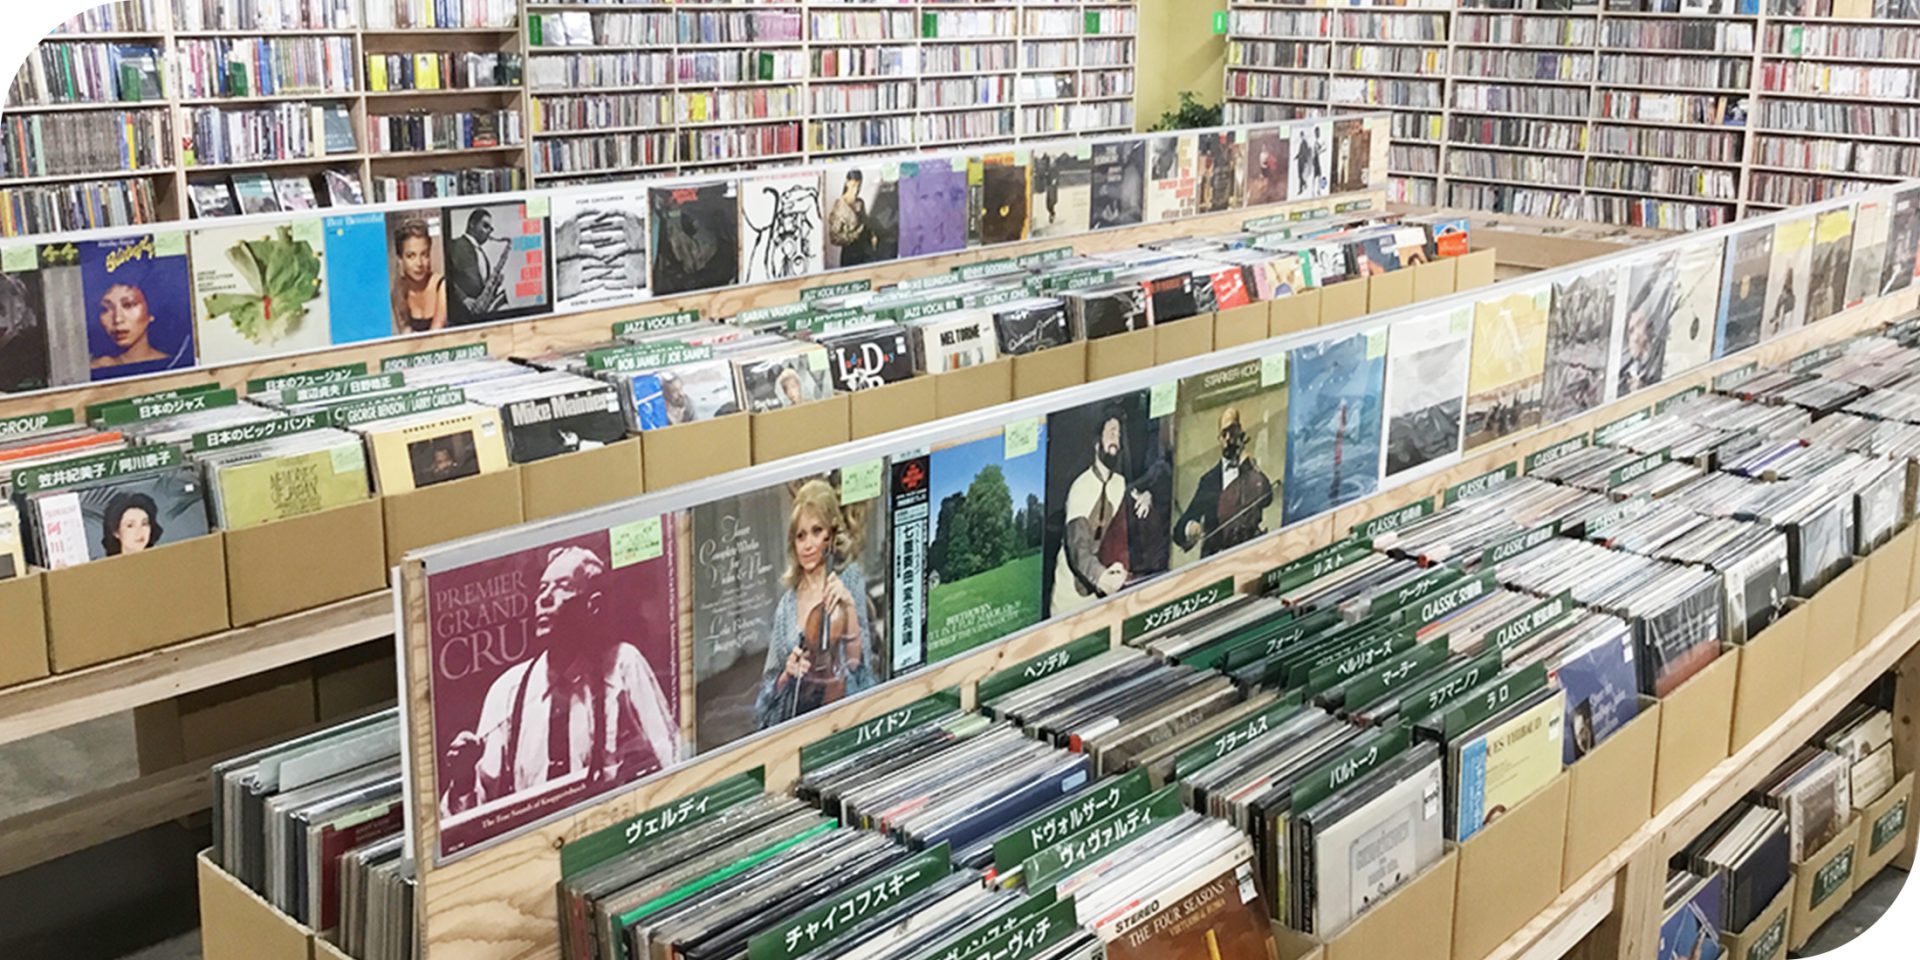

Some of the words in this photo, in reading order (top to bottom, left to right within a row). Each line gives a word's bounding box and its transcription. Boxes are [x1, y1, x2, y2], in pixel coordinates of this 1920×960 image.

[624, 320, 646, 334] JAZZ
[647, 316, 676, 330] VOCAL
[617, 357, 635, 371] BOB
[636, 353, 661, 368] JAMES
[667, 350, 683, 364] JOE
[682, 346, 711, 361] SAMPLE
[139, 395, 206, 420] 日本のジャズ
[347, 405, 378, 423] GEORGE
[510, 401, 552, 427] Mike
[206, 415, 317, 447] 日本のビッグ・バンド
[1456, 476, 1487, 500] CLASSIC
[1366, 512, 1401, 537] CLASSIC
[1312, 553, 1344, 578] リスト
[1492, 536, 1526, 562] CLASSIC
[435, 569, 528, 614] PREMIER
[1421, 590, 1460, 623] CLASSIC
[436, 592, 529, 639] GRAND
[1143, 588, 1220, 632] メンデルスゾーン
[1266, 628, 1304, 653] フォーレ
[1496, 614, 1533, 649] CLASSIC
[438, 617, 530, 681] CRU
[1023, 648, 1071, 679] ヘンデル
[1336, 638, 1393, 675] ベルリオーズ
[1381, 659, 1418, 686] マーラー
[1428, 668, 1480, 709] ラフマニノフ
[856, 709, 912, 745] ハイドン
[1214, 714, 1270, 757] ブラームス
[1328, 746, 1379, 790] バルトーク
[624, 795, 711, 845] ヴェルディ
[1030, 786, 1122, 850] ドヴォルザーク
[1058, 806, 1154, 869] ヴィヴァルディ
[784, 868, 922, 953] チャイコフスキー
[1115, 900, 1161, 934] STEREO
[1128, 924, 1153, 948] THE
[1152, 907, 1183, 935] FOUR
[1183, 879, 1226, 914] SEASONS
